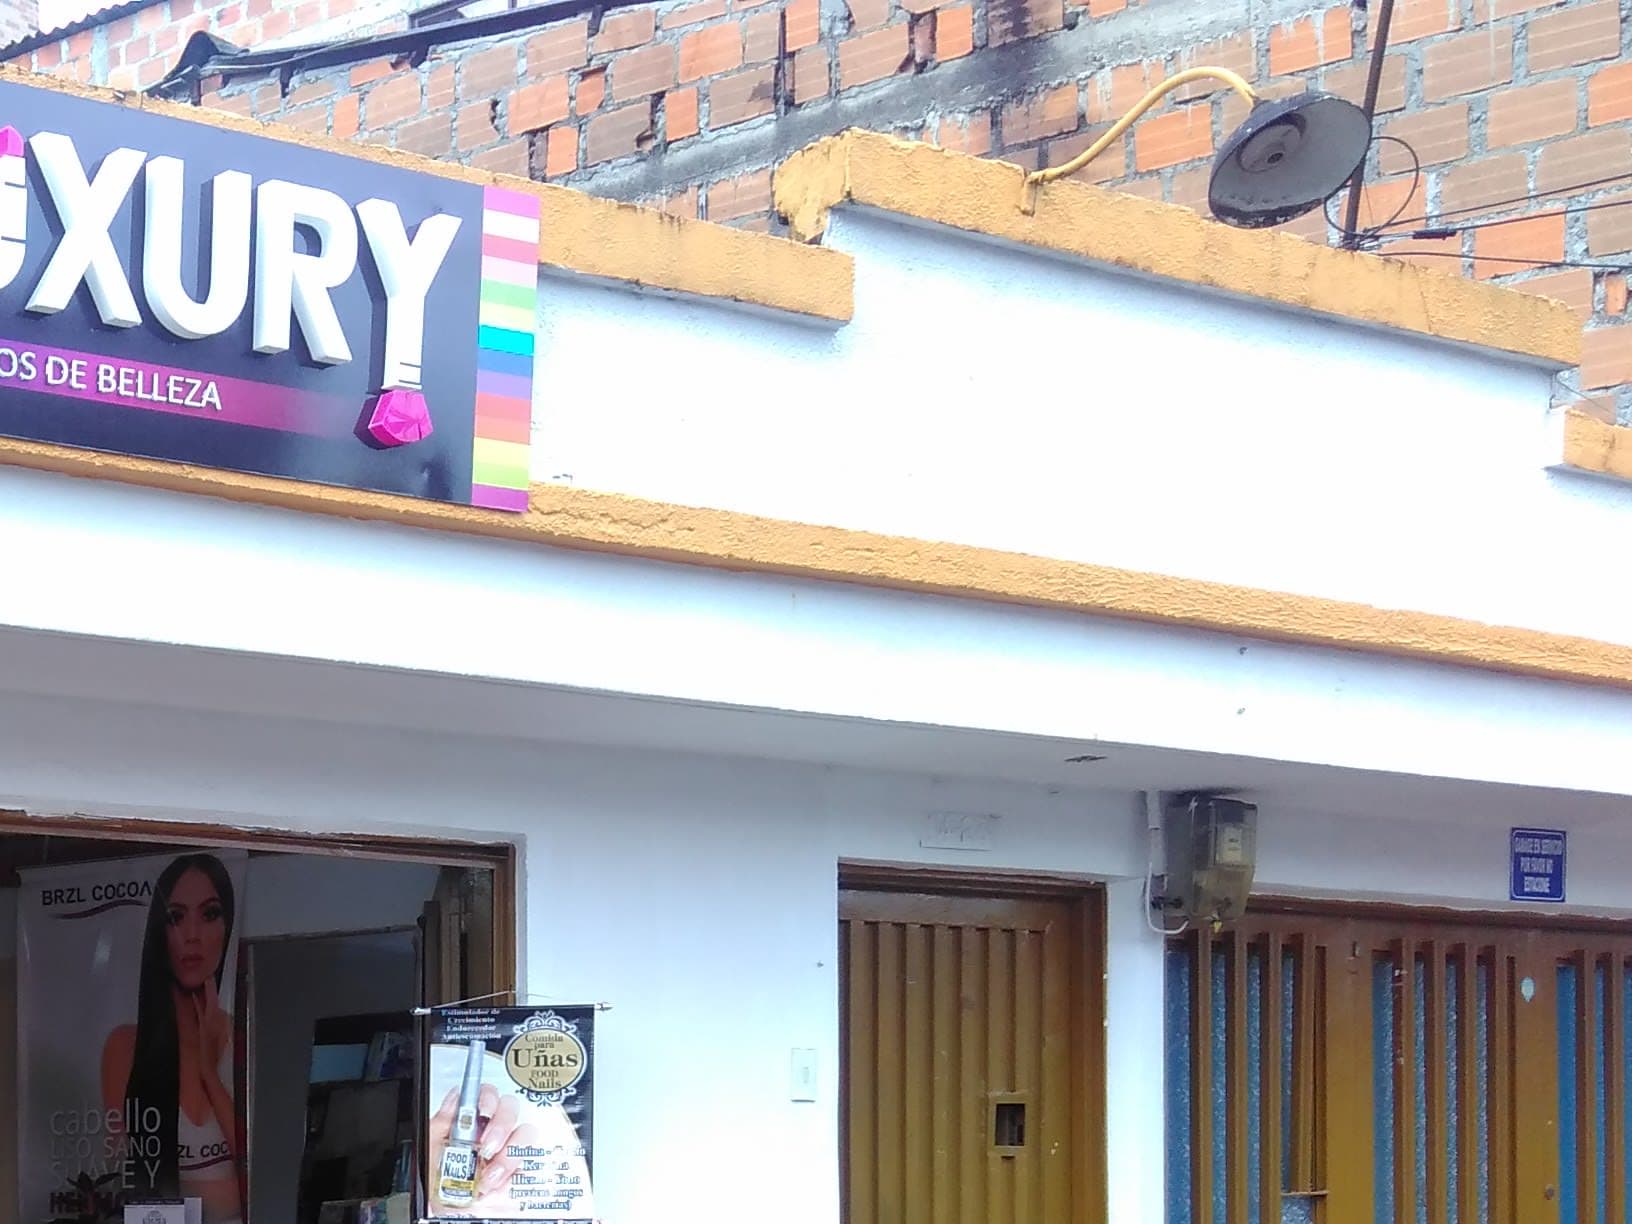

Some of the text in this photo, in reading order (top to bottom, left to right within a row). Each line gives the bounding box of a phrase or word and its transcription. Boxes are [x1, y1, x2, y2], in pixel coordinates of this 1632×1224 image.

[45, 355, 88, 389] DE
[97, 364, 223, 410] BELLEZA
[41, 881, 153, 906] BRZL COCOA
[512, 1048, 578, 1068] Uñas
[534, 1042, 554, 1050] para
[50, 1097, 161, 1135] cabello
[103, 1135, 161, 1158] SANO
[446, 1151, 467, 1163] FOOD
[144, 1160, 161, 1189] Y
